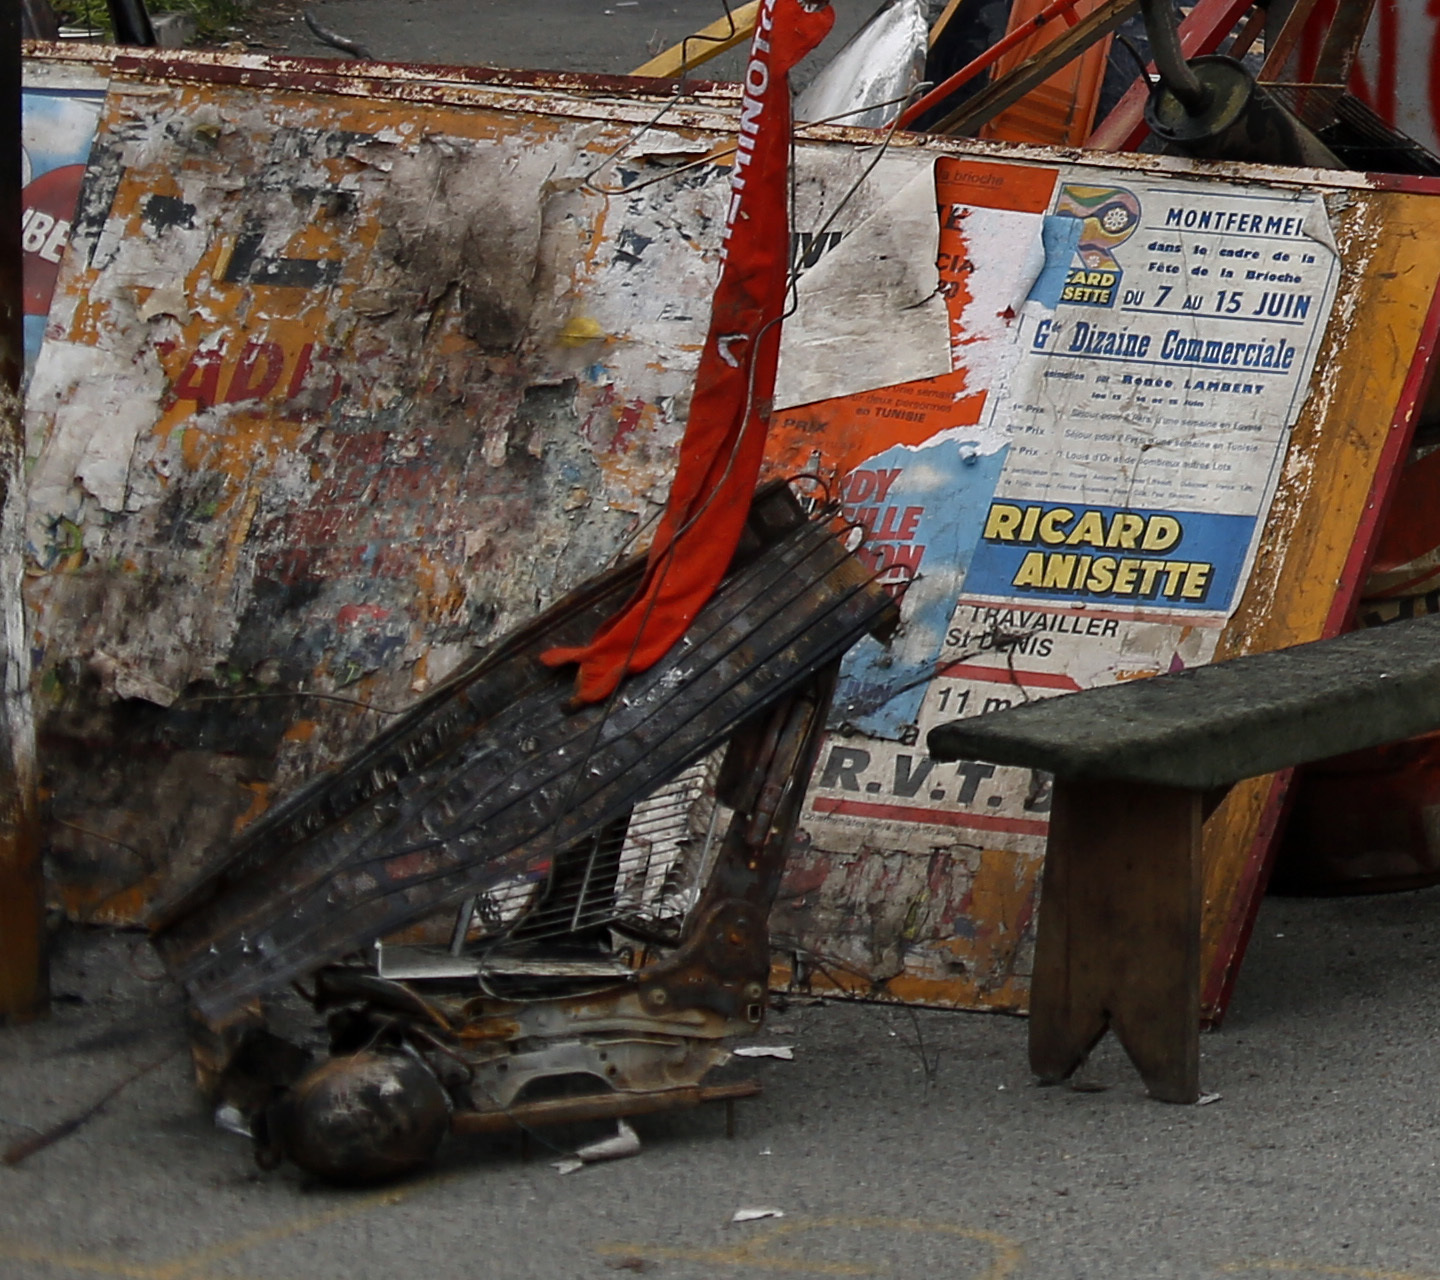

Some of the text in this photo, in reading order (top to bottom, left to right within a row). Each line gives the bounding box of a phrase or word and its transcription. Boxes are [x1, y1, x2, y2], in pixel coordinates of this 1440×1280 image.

[22, 206, 71, 264] BE
[1164, 207, 1306, 237] MONTFERMEI
[1148, 241, 1316, 264] dans le cadre de la
[1064, 269, 1116, 288] CARD
[1148, 262, 1302, 284] Fête de la Brioche
[1062, 286, 1111, 305] SETTE
[1123, 286, 1313, 320] DU 7 AU 15 JUIN
[1068, 319, 1152, 359] Dizaine
[1160, 330, 1296, 370] Commerciale
[1183, 380, 1265, 395] LAMBERT
[856, 407, 927, 424] en TUNISIE
[1024, 405, 1045, 415] Prix
[1025, 426, 1045, 436] Prix
[1019, 446, 1039, 456] Prix
[1065, 451, 1090, 461] Louis
[1212, 461, 1232, 471] Lots
[983, 503, 1183, 554] RICARD
[1011, 551, 1213, 600] ANISETTE
[971, 606, 1119, 638] TRAVAILLER
[945, 628, 1054, 657] St DENIS
[938, 687, 971, 715] 11
